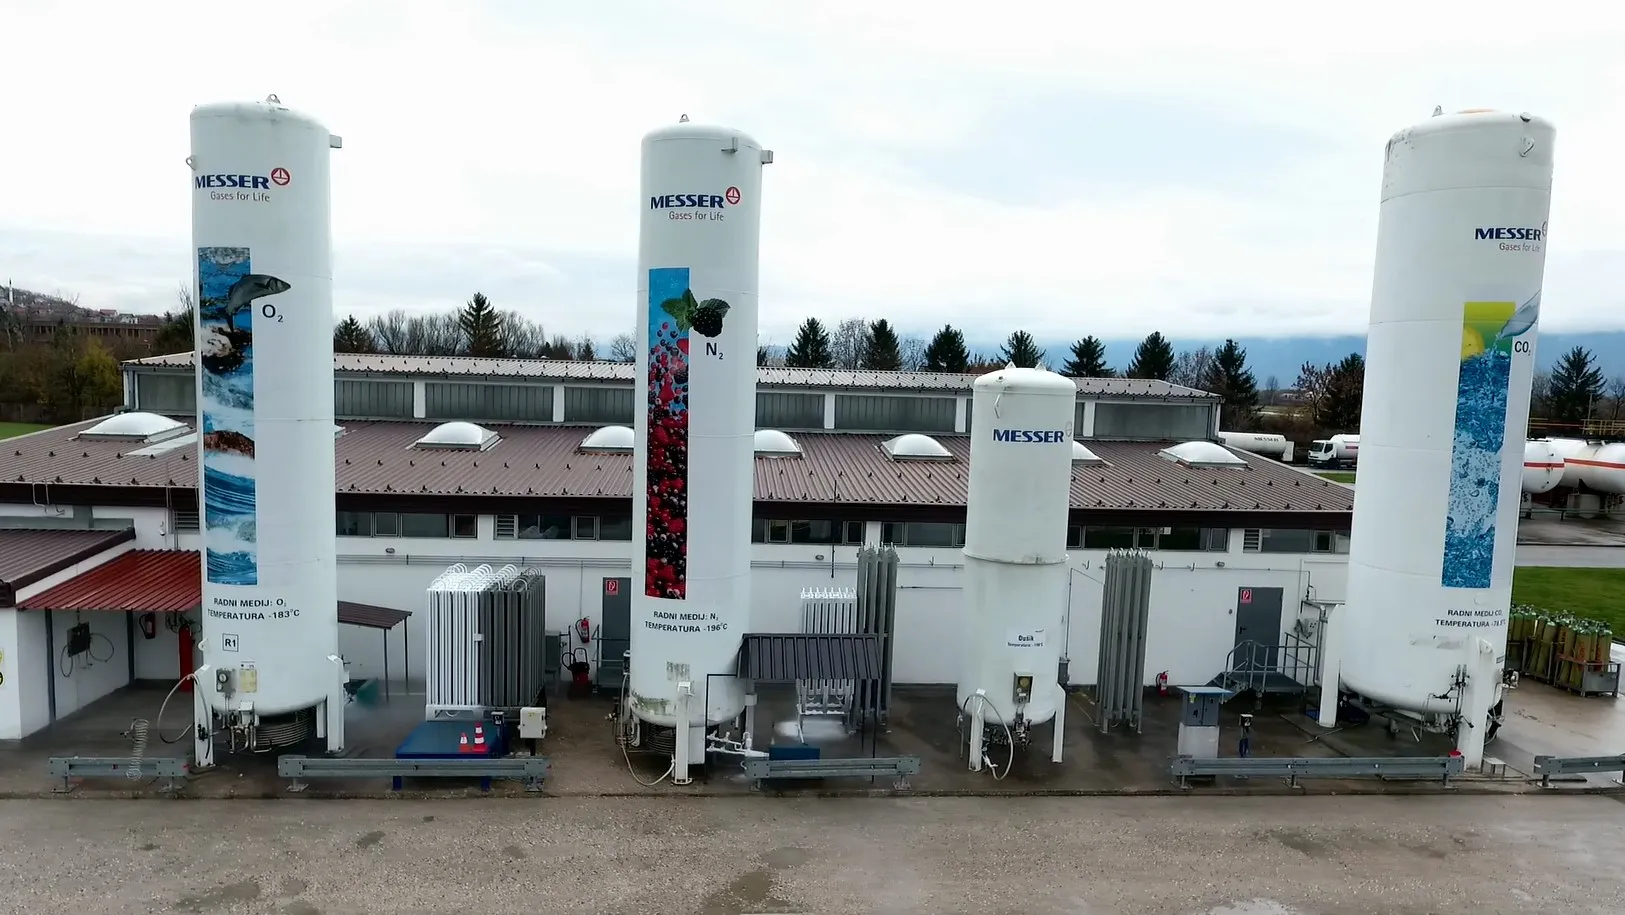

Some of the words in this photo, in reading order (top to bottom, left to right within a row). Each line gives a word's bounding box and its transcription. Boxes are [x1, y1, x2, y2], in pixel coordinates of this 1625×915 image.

[195, 174, 270, 190] MESSER
[210, 190, 234, 201] Gases
[237, 191, 250, 201] for
[253, 192, 270, 202] Life
[650, 194, 724, 209] MESSER
[669, 210, 692, 220] Gases
[695, 211, 707, 220] for
[709, 211, 724, 221] Life
[1475, 227, 1541, 241] MESSER
[1499, 242, 1521, 251] Gases
[993, 428, 1064, 443] MESSER
[213, 597, 237, 607] RADNI
[207, 608, 265, 620] TEMPERATURA
[653, 610, 677, 620] RADNI
[679, 613, 708, 621] MEDIJ:
[1447, 609, 1472, 617] RADNI
[645, 620, 701, 632] TEMPERATURA
[1435, 619, 1490, 628] TEMPERATURA
[224, 638, 236, 647] R1
